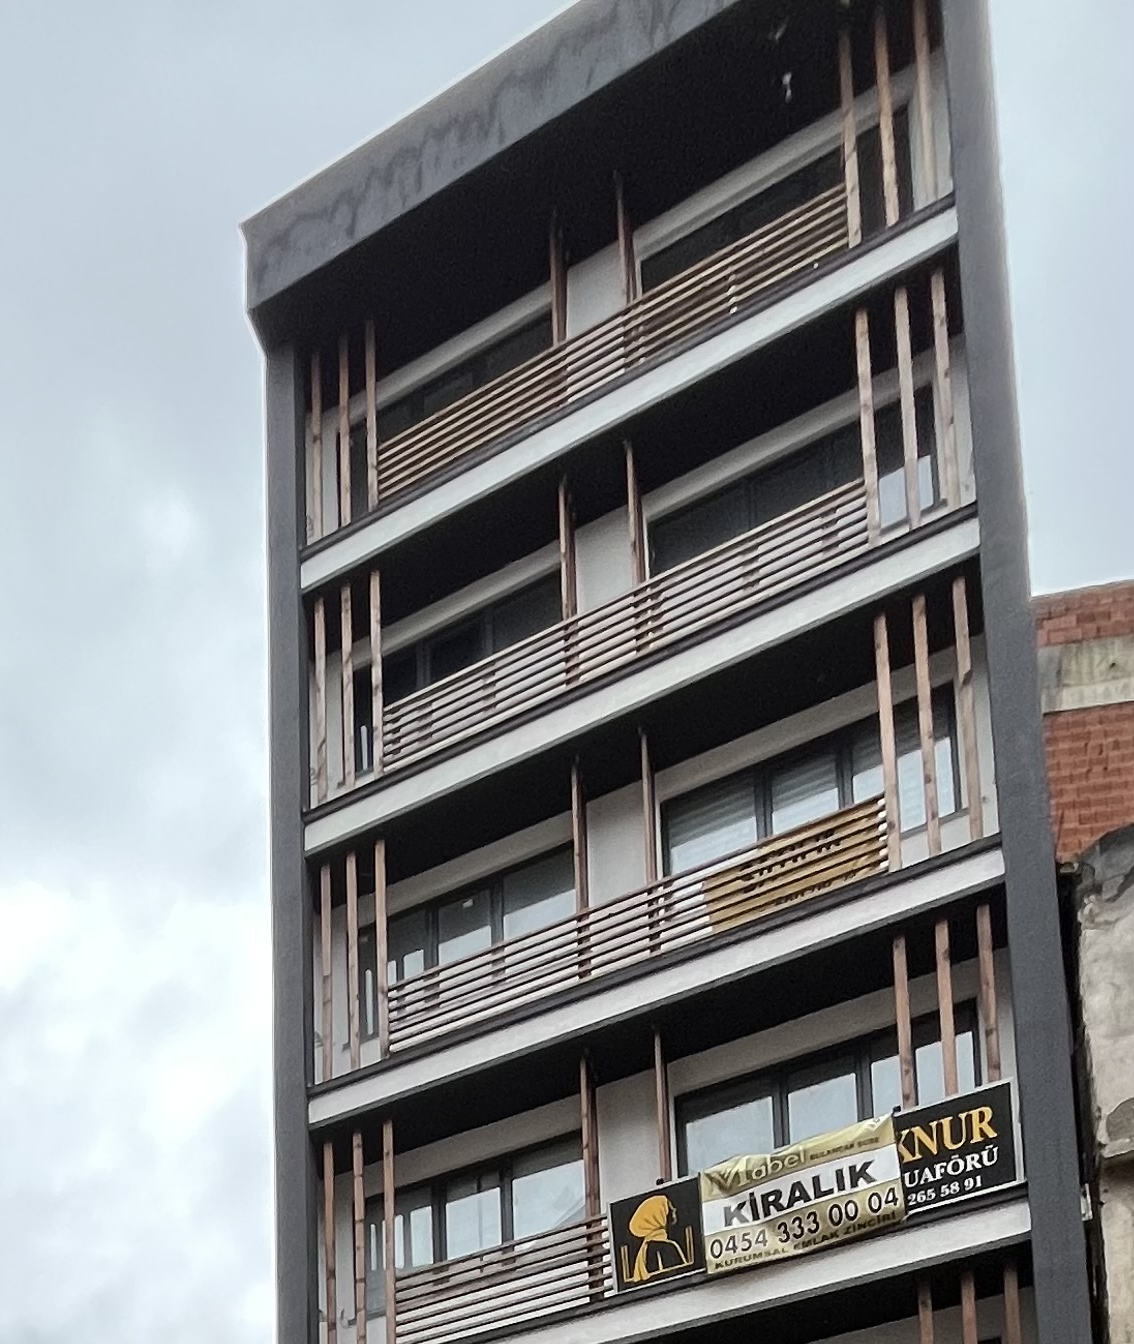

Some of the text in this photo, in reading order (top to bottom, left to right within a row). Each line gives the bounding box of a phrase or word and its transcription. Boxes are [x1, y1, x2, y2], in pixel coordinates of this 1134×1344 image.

[903, 1144, 999, 1188] UAFÖRÜ
[723, 1158, 878, 1227] KİRALIK
[907, 1175, 982, 1206] 265 58 91
[710, 1185, 899, 1260] 0454 333 00 04
[715, 1246, 789, 1270] KURUMSAL
[792, 1230, 840, 1252] EMLAK
